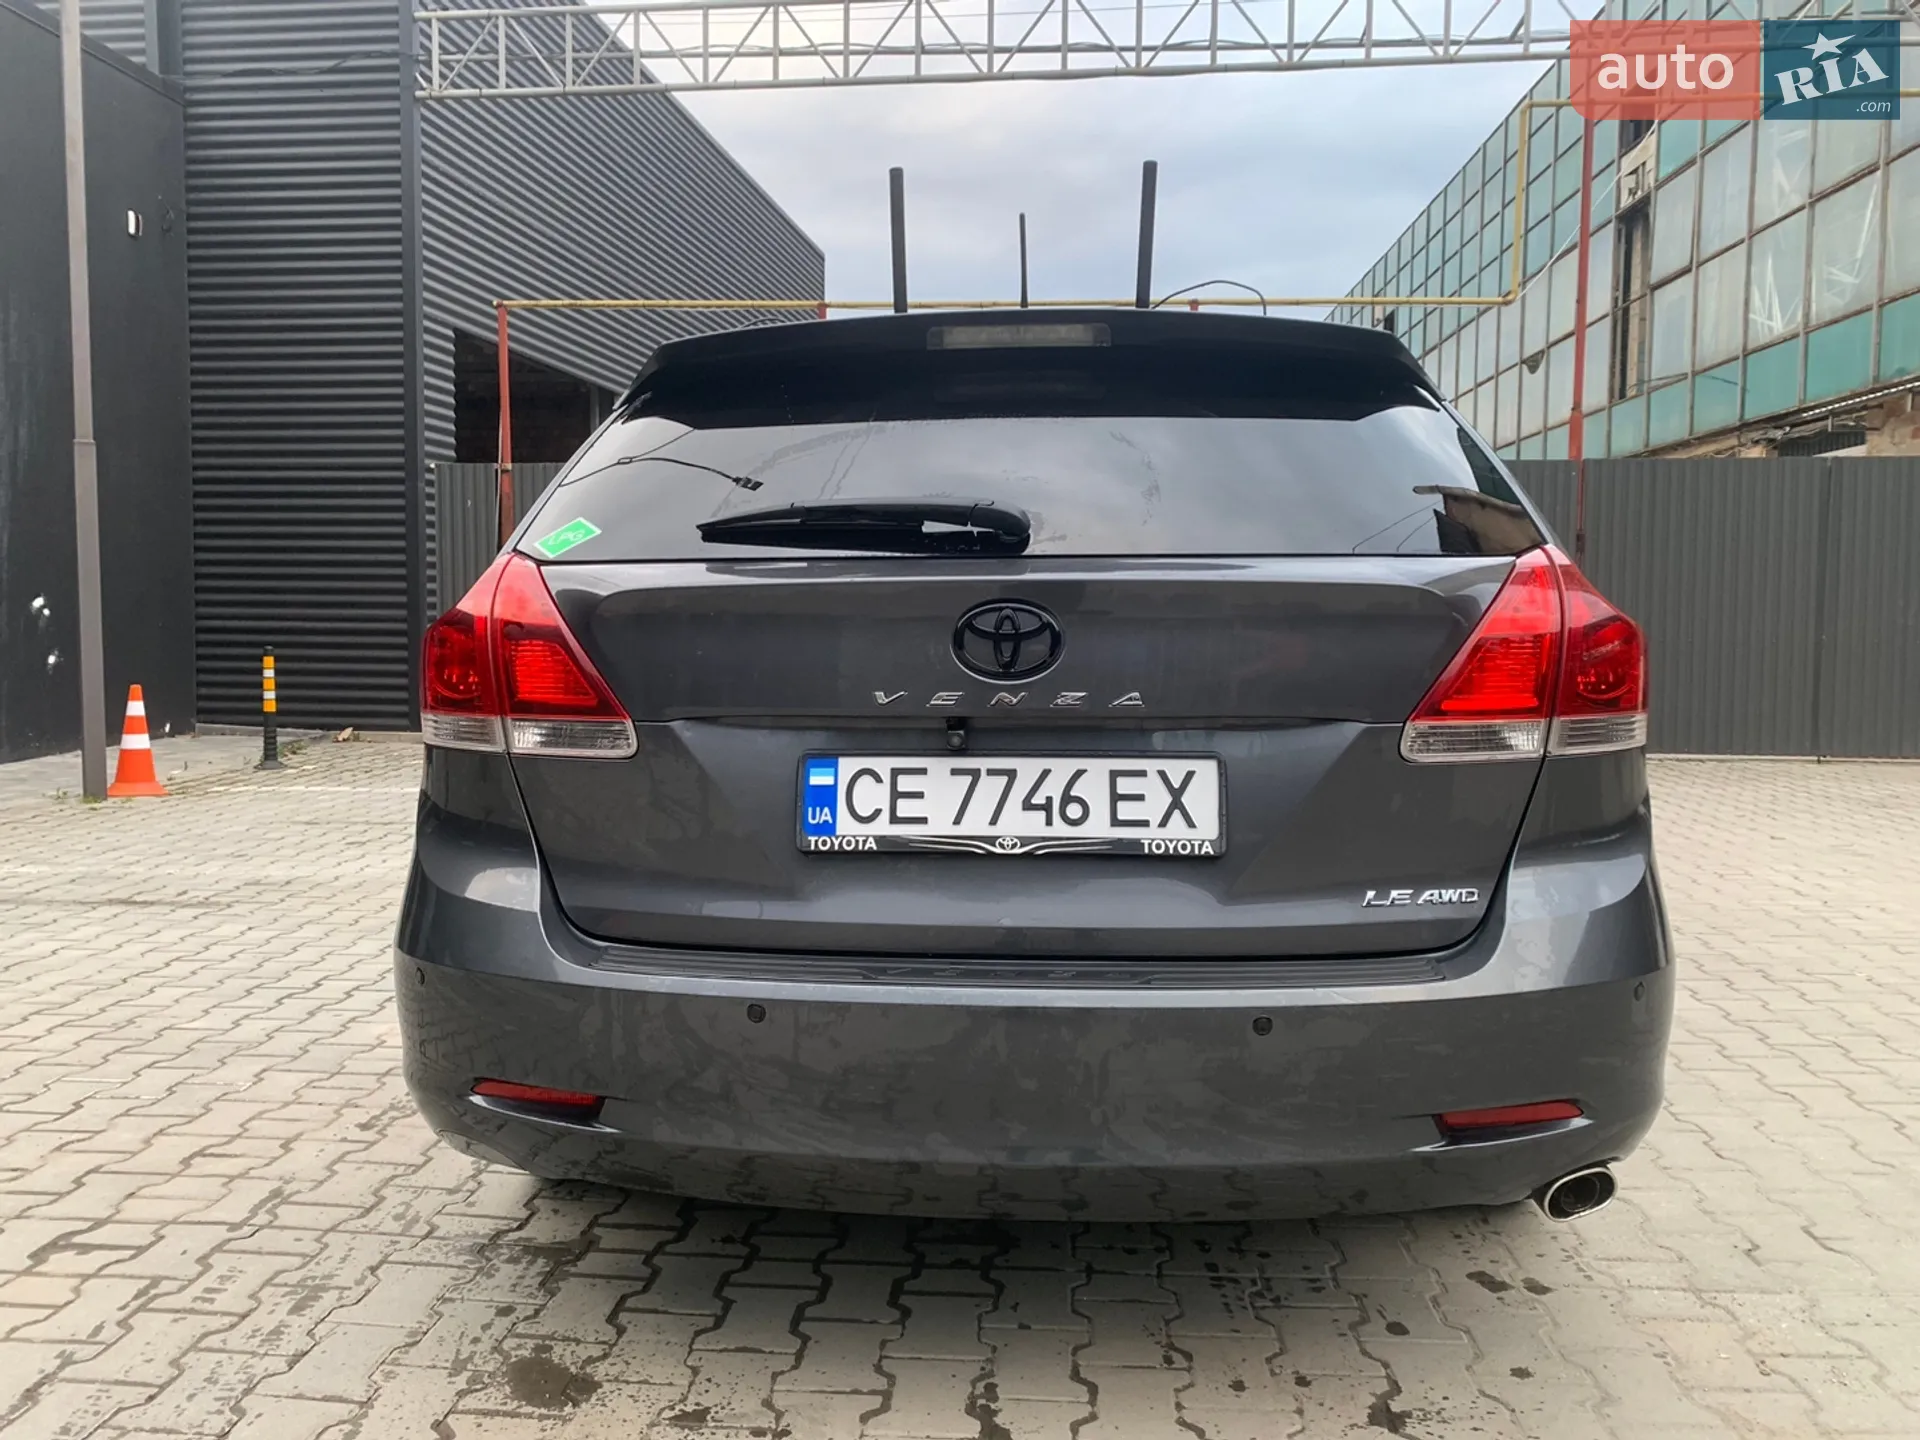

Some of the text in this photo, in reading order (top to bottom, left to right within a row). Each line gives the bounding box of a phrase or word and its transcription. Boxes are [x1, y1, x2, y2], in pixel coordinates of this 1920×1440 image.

[872, 691, 1145, 707] VENZA
[845, 767, 1198, 829] CE 7746 EX
[808, 806, 833, 825] UA
[808, 836, 878, 851] TOYOTA
[1140, 839, 1214, 855] TOYOTA
[1362, 887, 1480, 907] LE AWD
